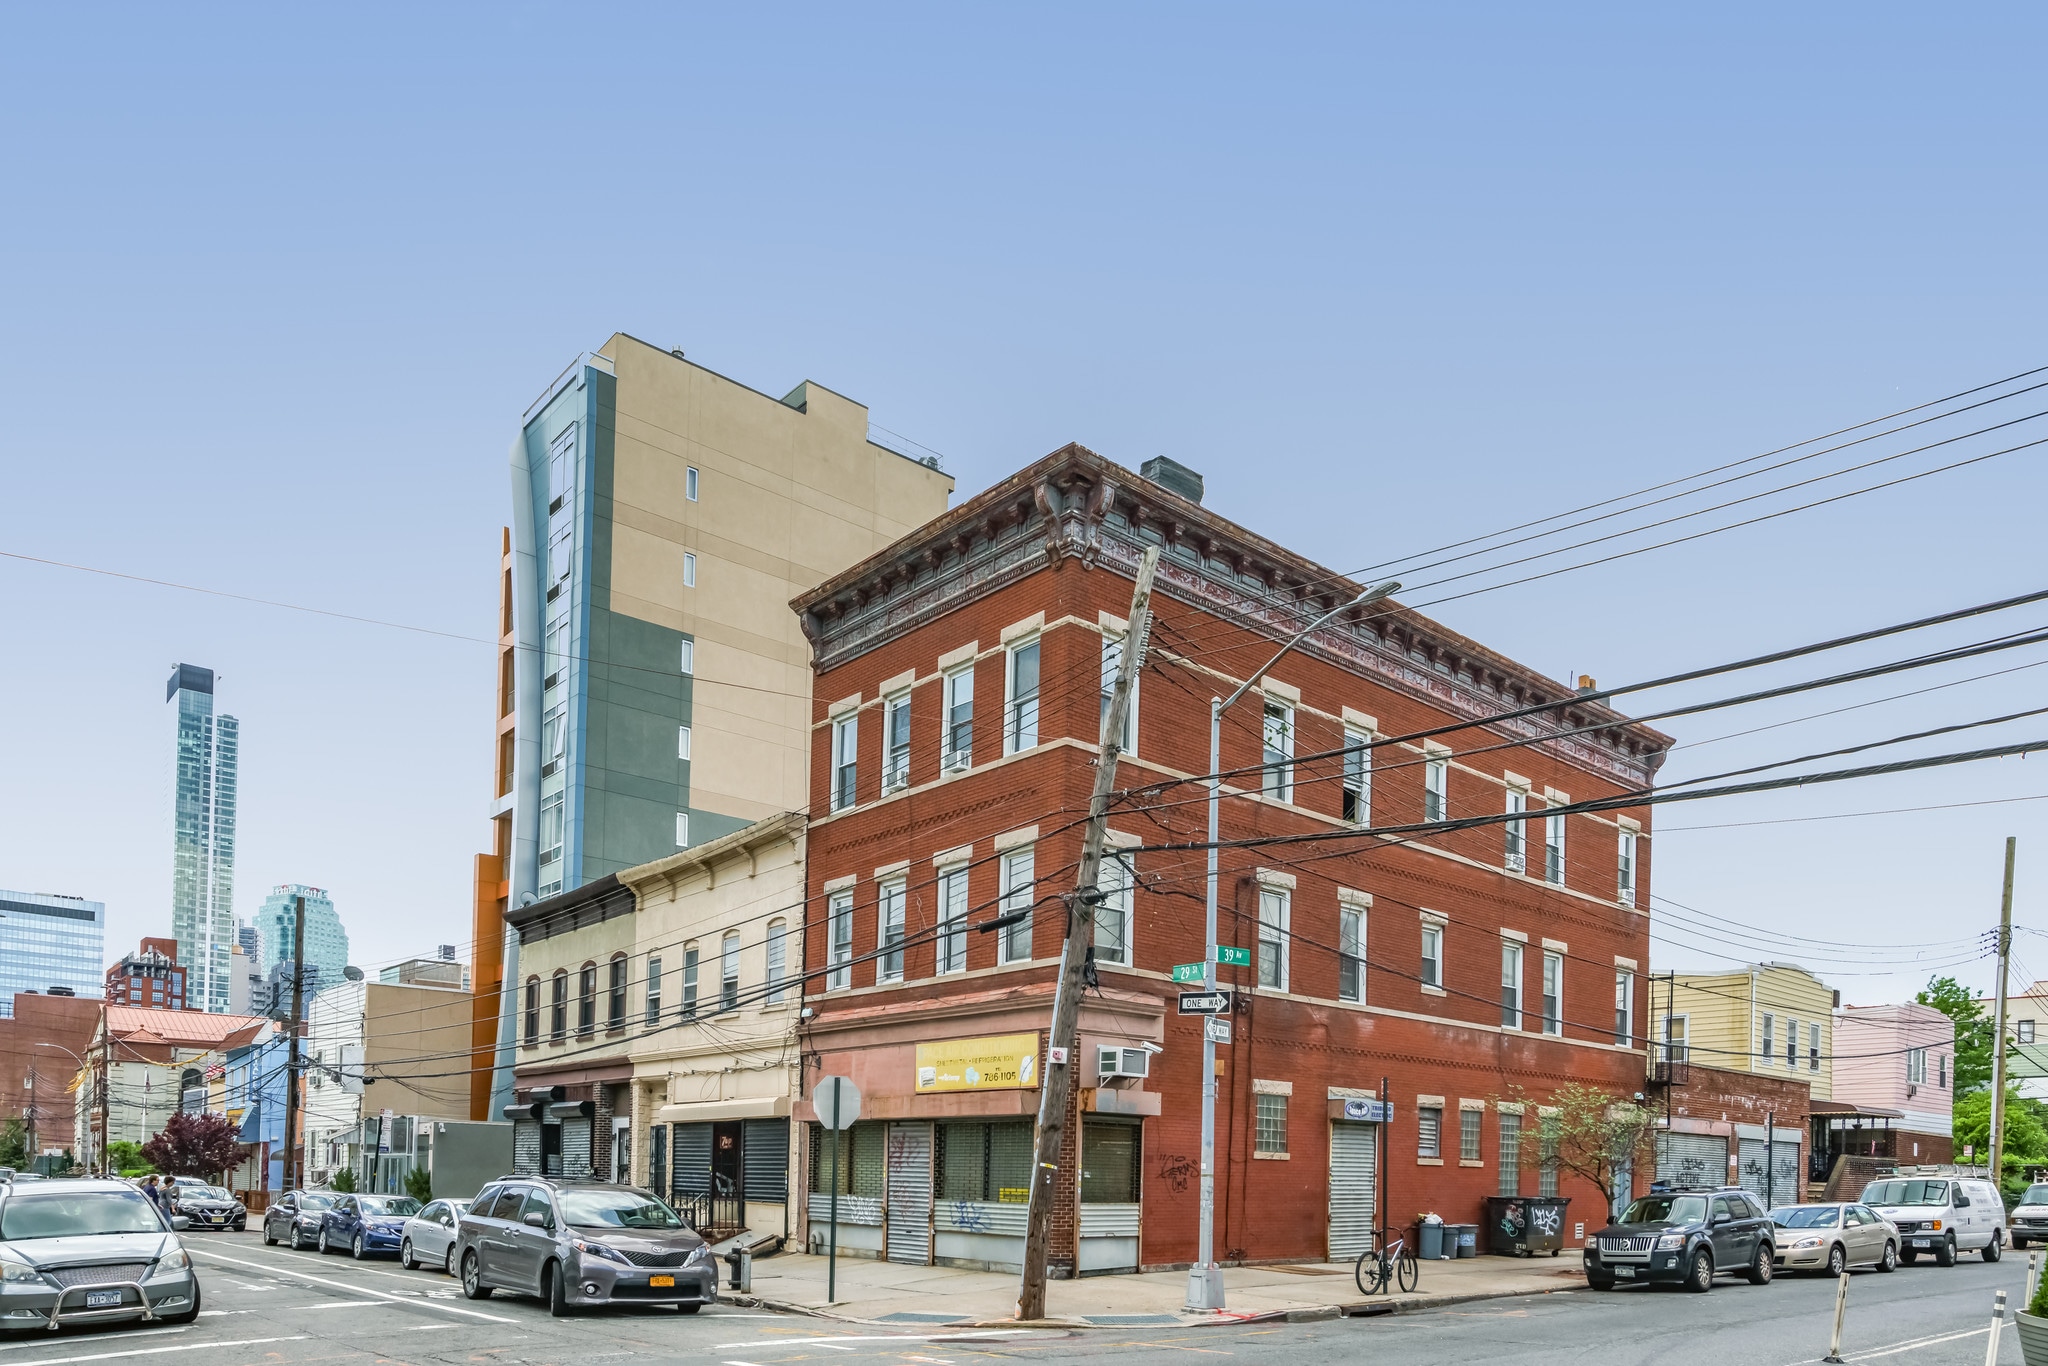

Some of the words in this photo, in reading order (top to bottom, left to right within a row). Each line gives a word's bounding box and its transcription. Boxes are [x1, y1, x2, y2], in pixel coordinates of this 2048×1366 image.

[1224, 948, 1234, 962] 39
[1180, 966, 1190, 980] 29
[1186, 999, 1202, 1008] ONE
[1208, 998, 1223, 1007] WAY
